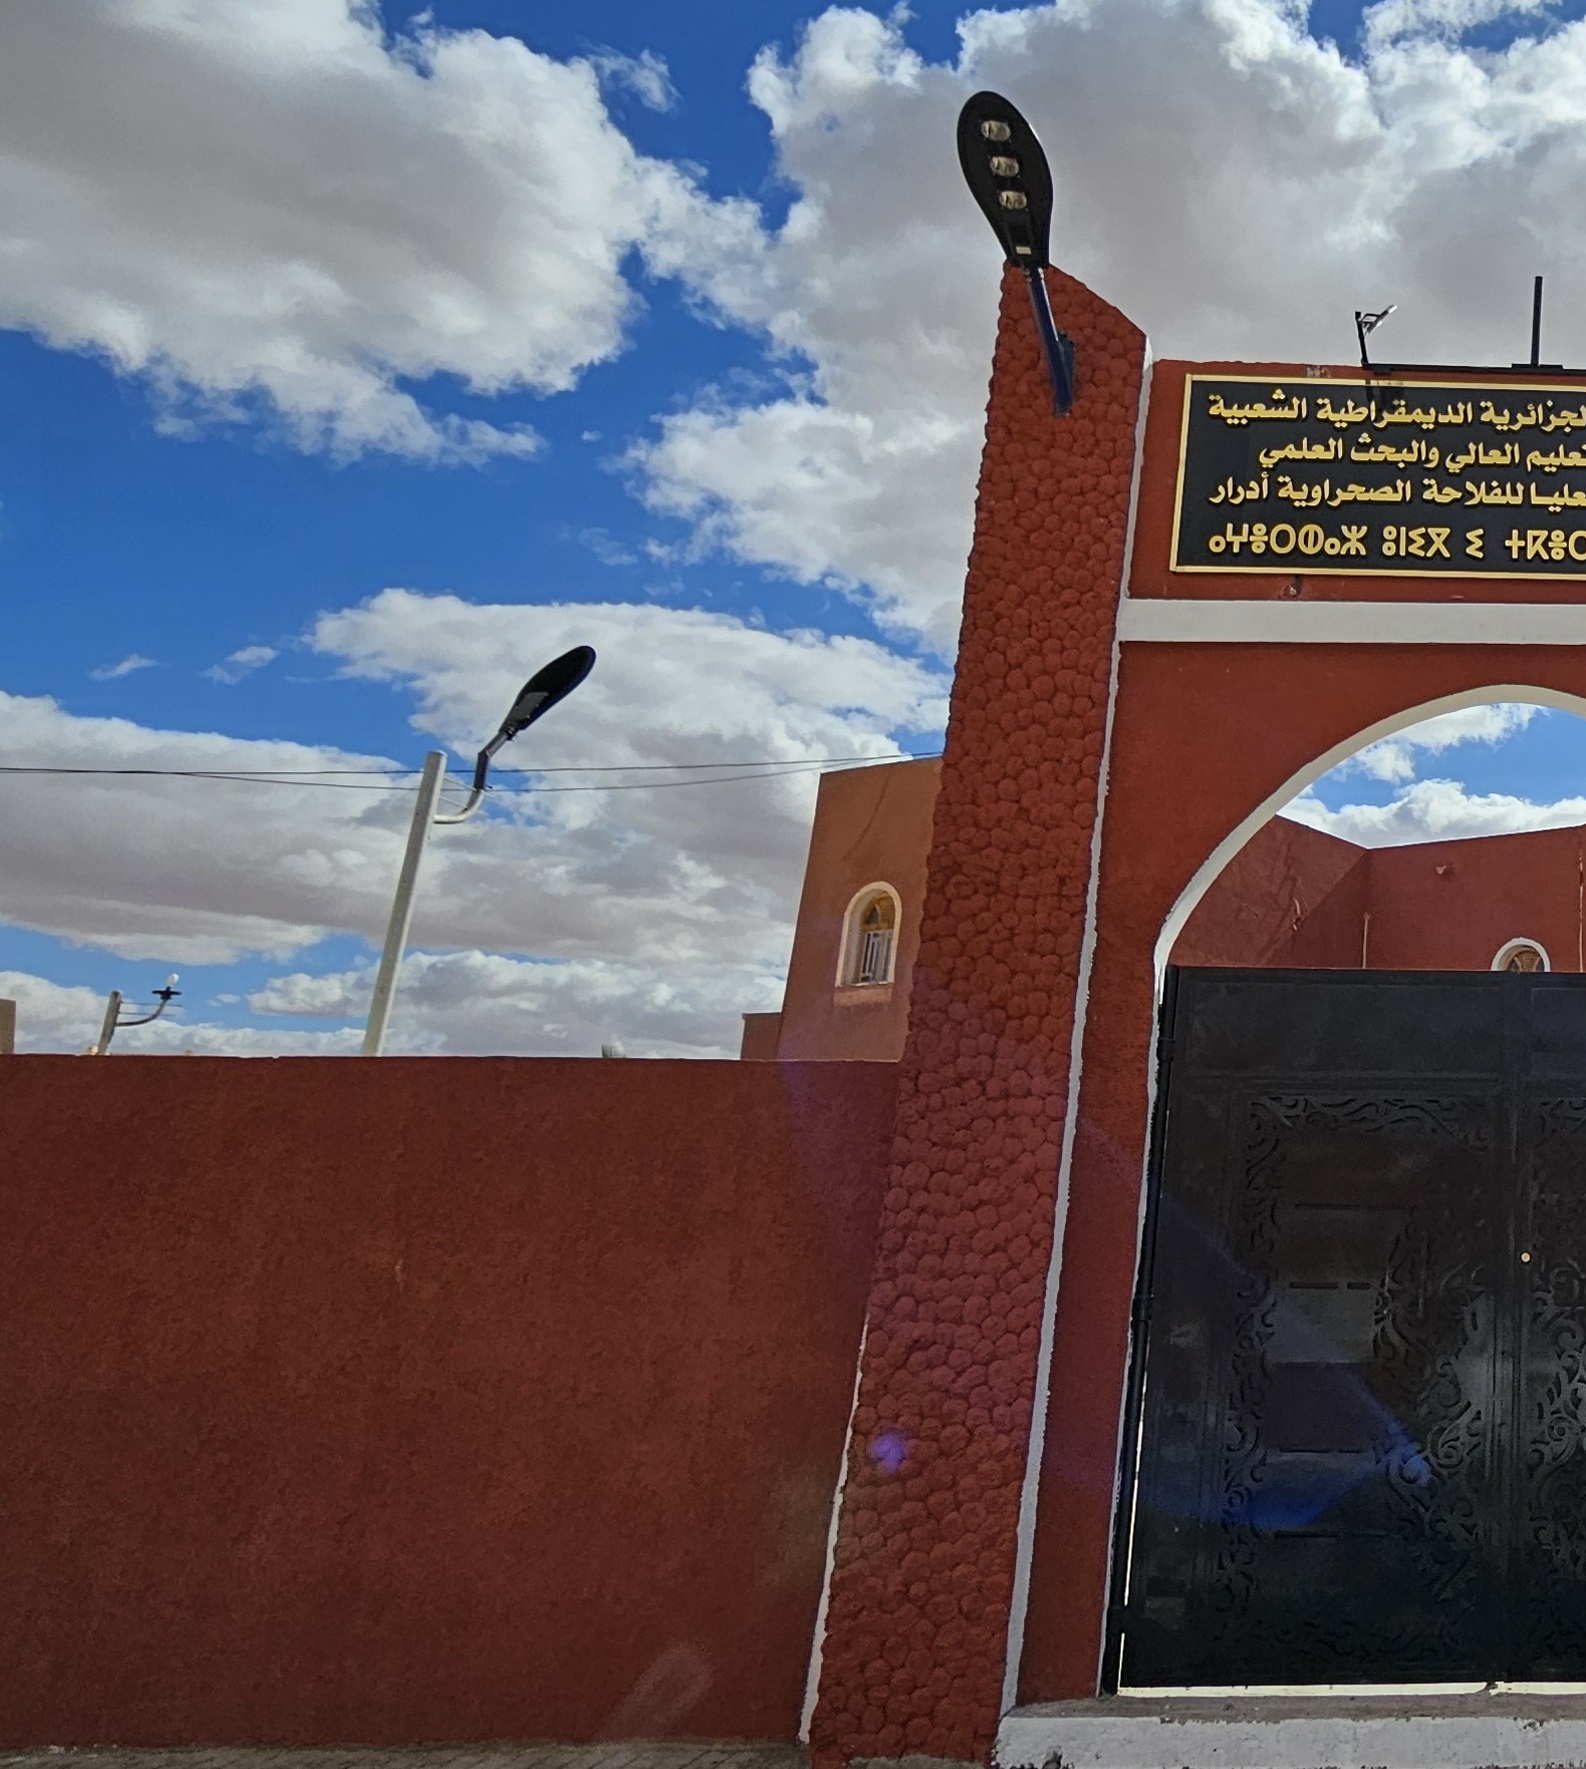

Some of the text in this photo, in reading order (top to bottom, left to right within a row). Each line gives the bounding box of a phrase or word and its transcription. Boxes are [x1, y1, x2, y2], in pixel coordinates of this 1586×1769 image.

[1208, 388, 1308, 425] الشعبية
[1316, 396, 1473, 429] الديمقراطية
[1258, 436, 1343, 468] العلمي
[1350, 432, 1440, 468] والبحث
[1444, 441, 1520, 473] العالي
[1208, 471, 1269, 505] أدرار
[1277, 475, 1412, 508] الصحراوية
[1423, 477, 1525, 507] للفلاحة
